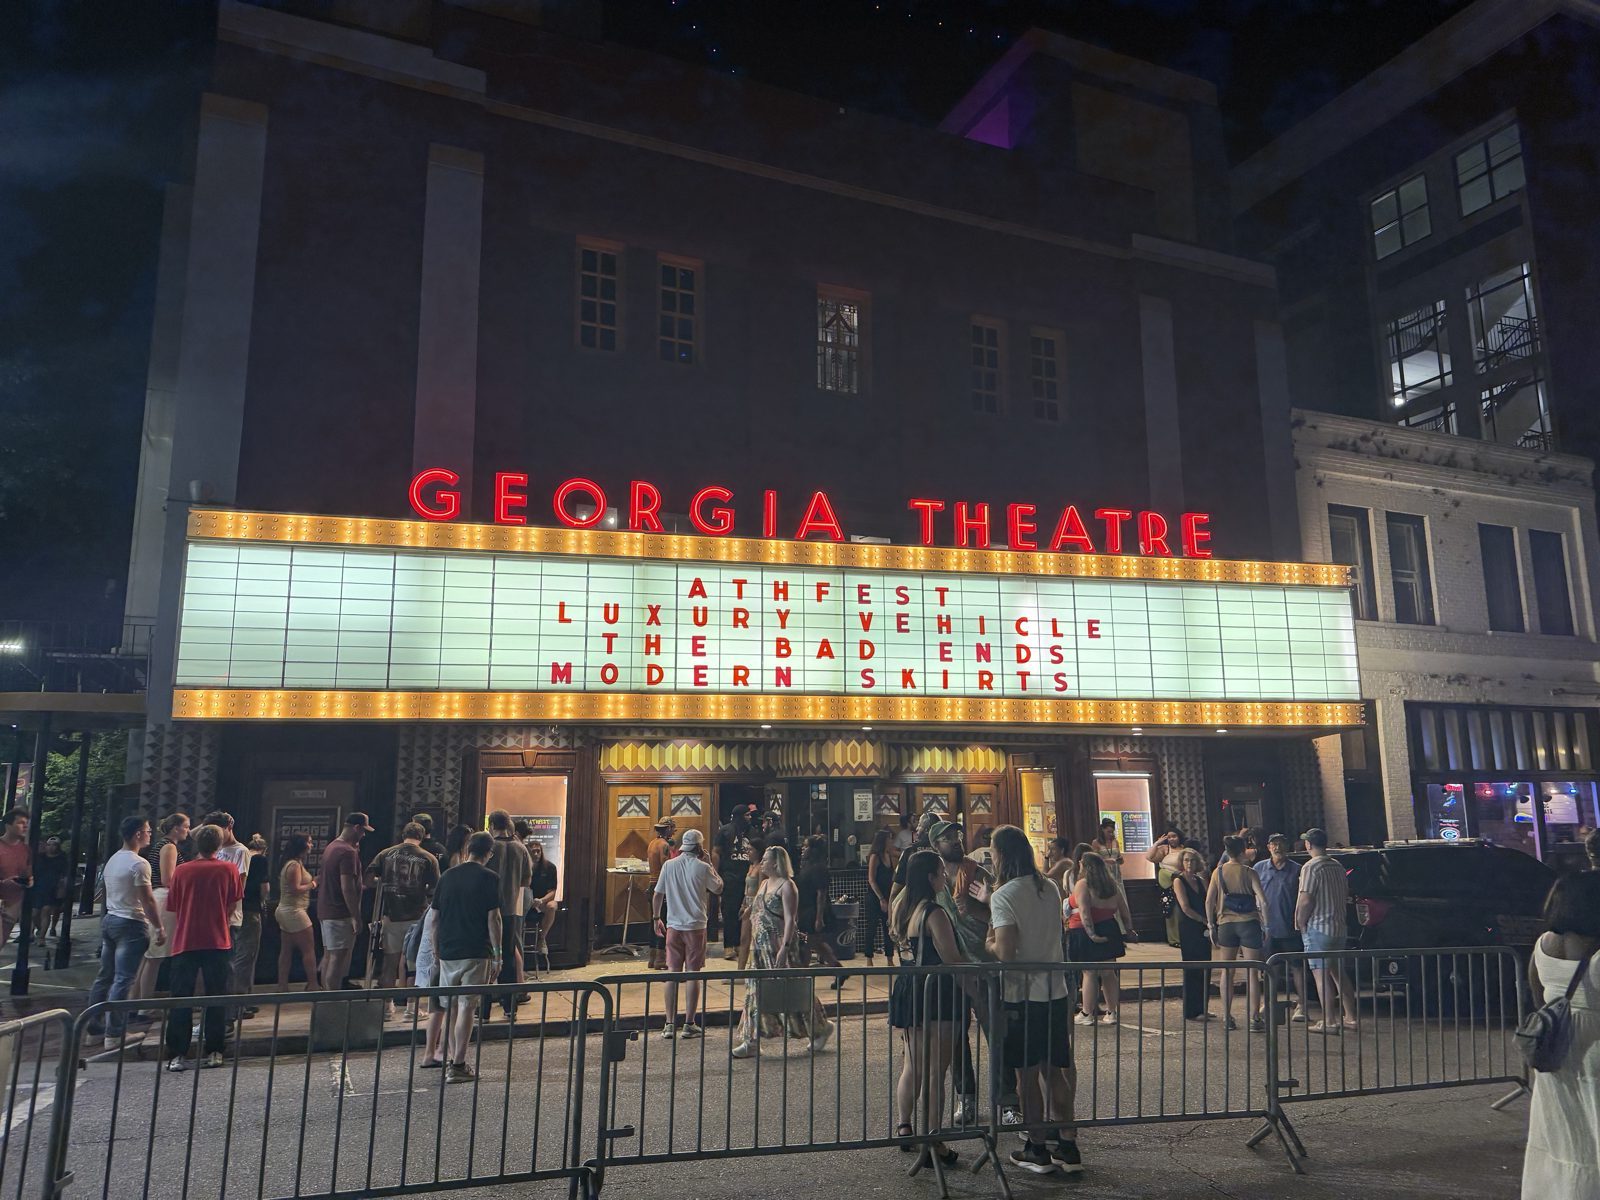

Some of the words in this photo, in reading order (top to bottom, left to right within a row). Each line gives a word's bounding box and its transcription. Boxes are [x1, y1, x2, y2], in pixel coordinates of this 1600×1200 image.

[409, 467, 845, 540] GEORGIA
[908, 498, 1213, 559] THEATRE
[688, 577, 950, 608] ATHFEST
[558, 601, 791, 630] LUXURY
[858, 611, 1101, 639] VEHICLE
[601, 632, 707, 658] THE
[775, 636, 876, 661] BAD
[938, 641, 1065, 665] ENDS
[550, 661, 792, 688] MODERN
[860, 667, 1069, 692] SKIRTS
[416, 776, 442, 788] 215
